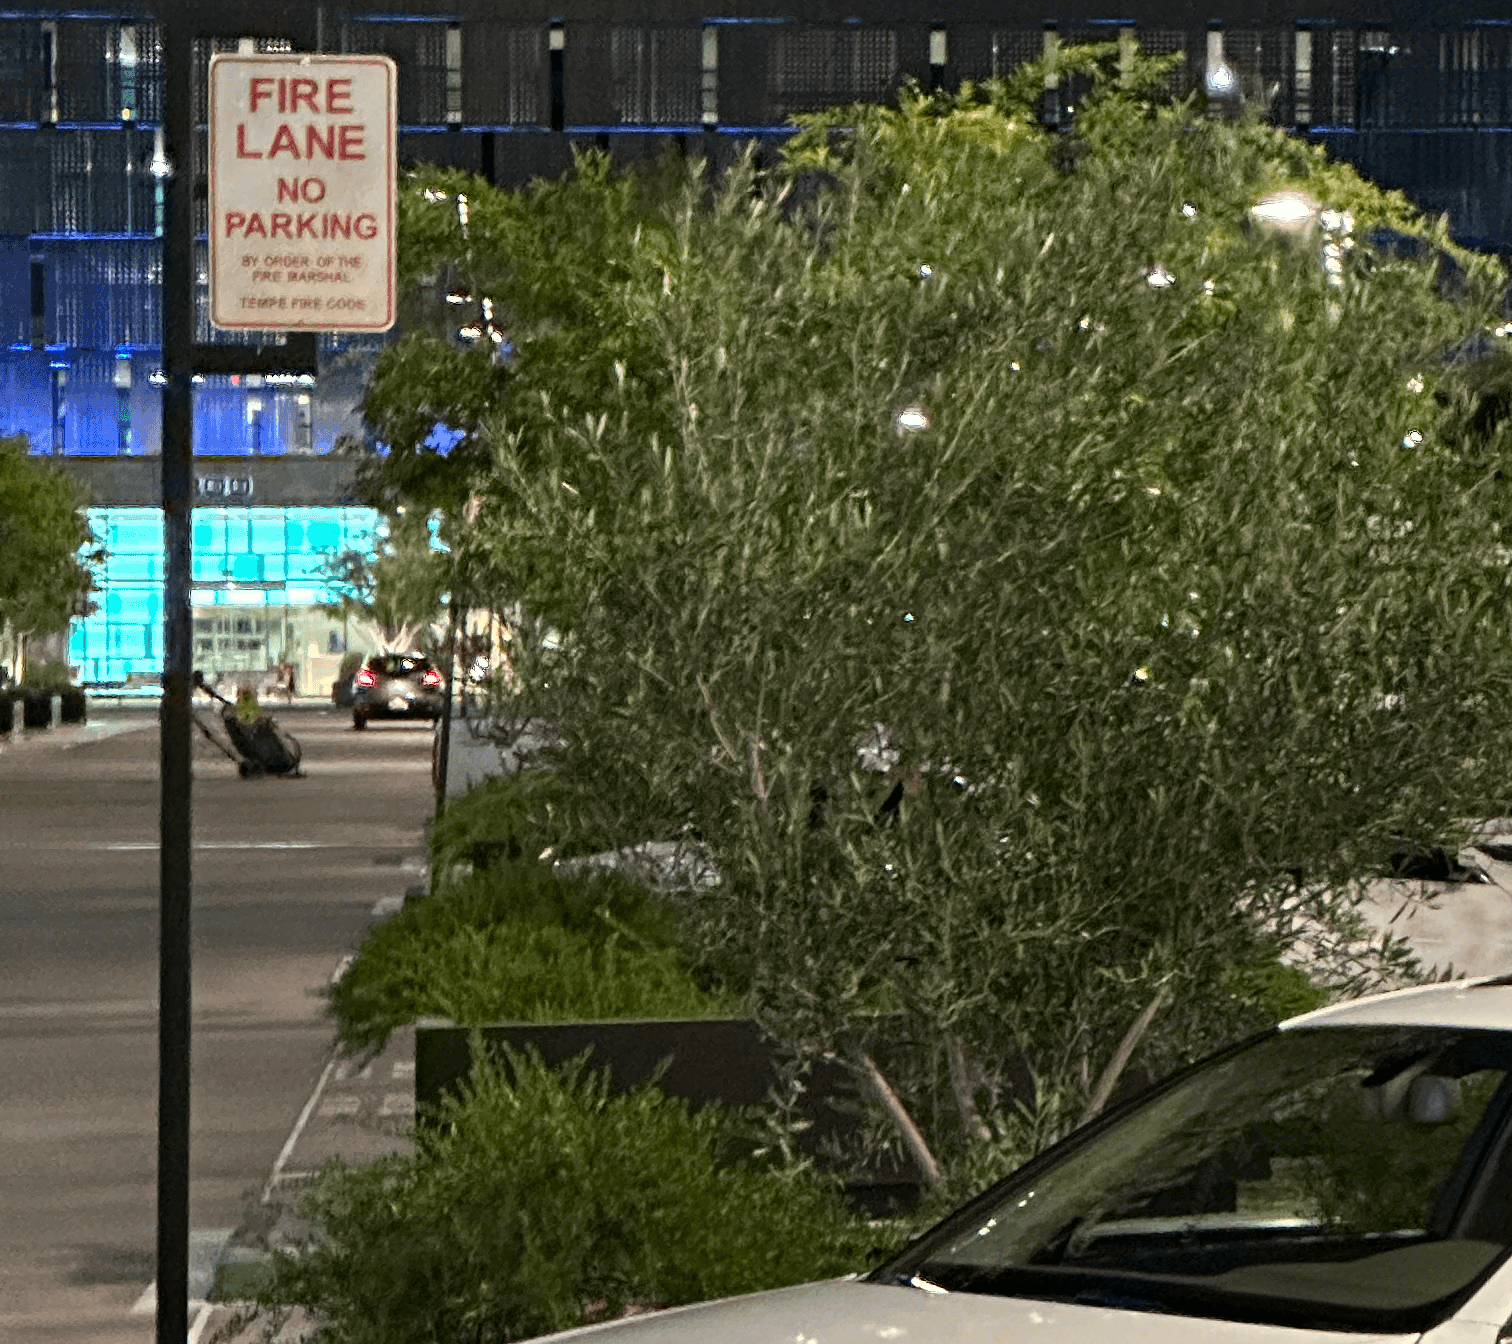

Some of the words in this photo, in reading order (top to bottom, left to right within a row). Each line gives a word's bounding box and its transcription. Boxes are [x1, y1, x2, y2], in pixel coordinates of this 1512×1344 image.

[249, 77, 353, 114] FIRE
[236, 123, 366, 161] LANE
[277, 177, 327, 204] NO
[225, 212, 378, 240] PARKING
[241, 255, 258, 267] BY
[263, 255, 309, 268] ORDER
[316, 256, 334, 267] OF
[338, 256, 362, 268] THE
[252, 271, 282, 282] FIRE
[287, 271, 350, 283] MARSHAL
[240, 297, 287, 309] TEMPE
[291, 297, 322, 310] FIRE
[326, 297, 366, 310] CODE
